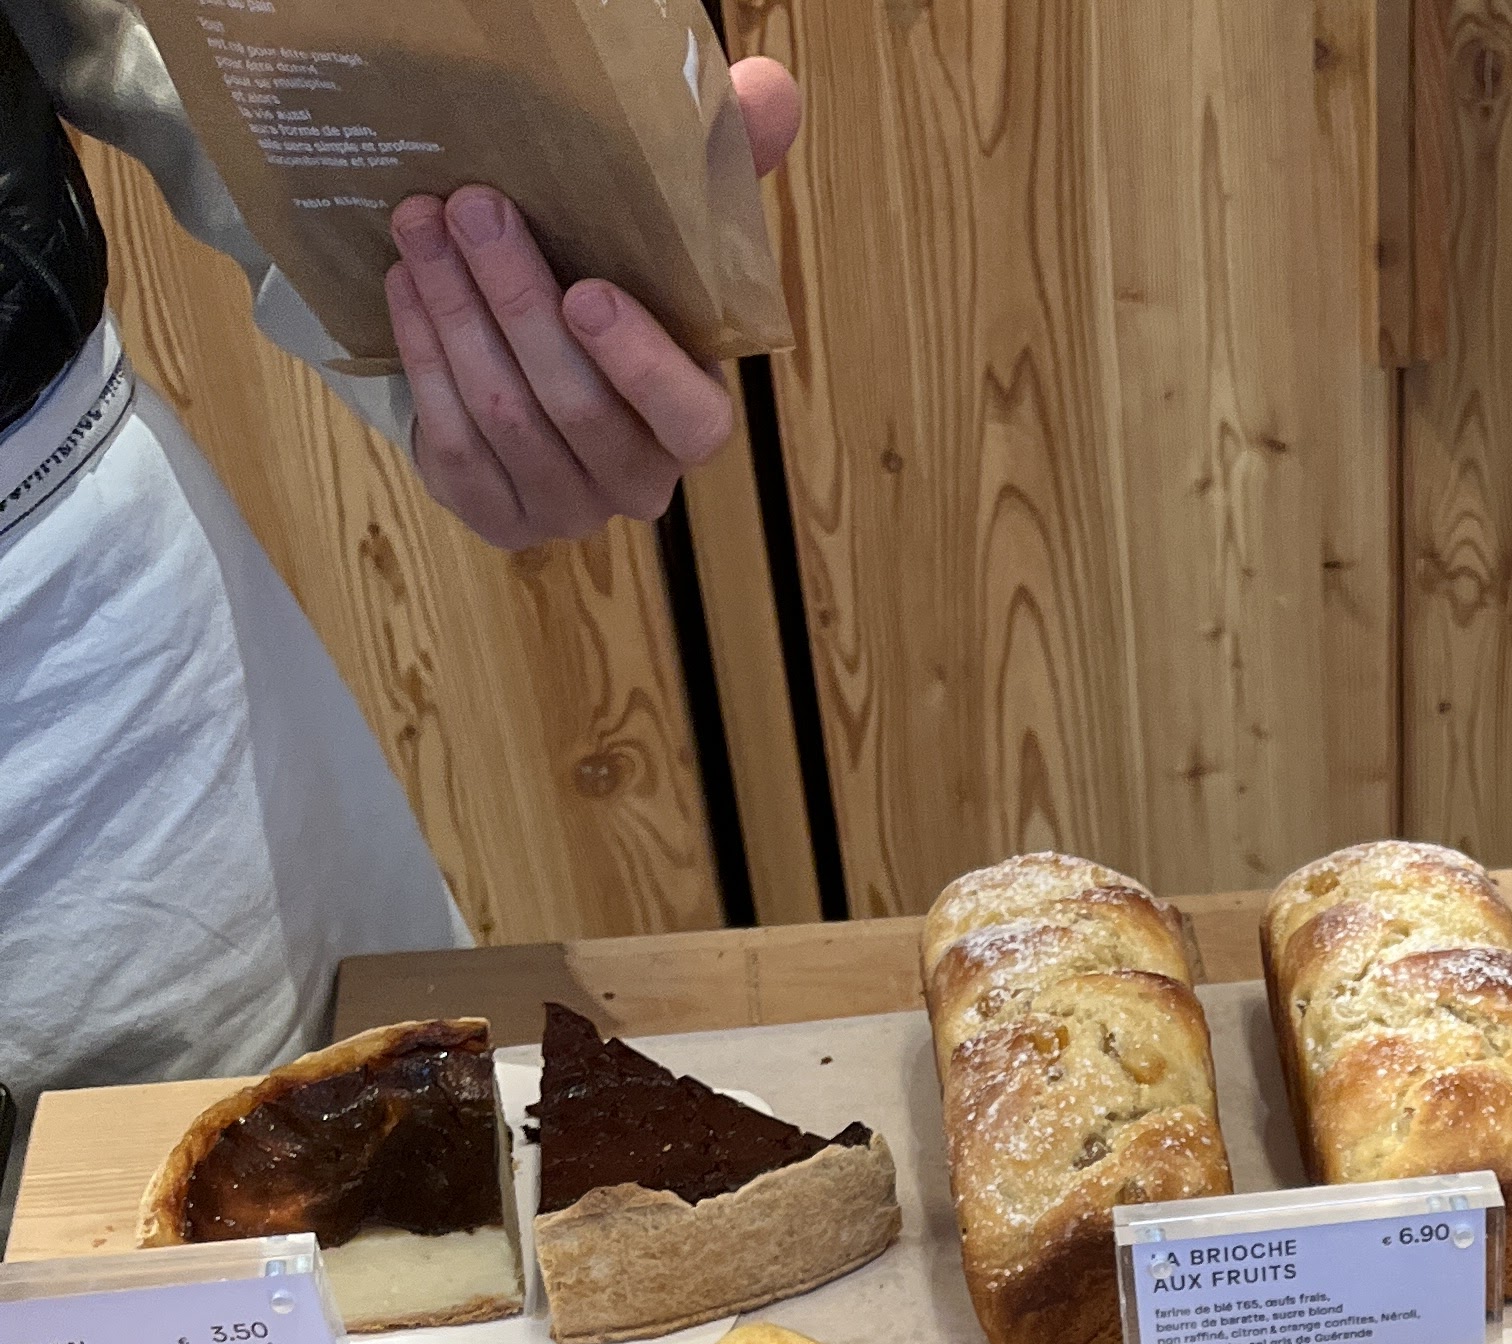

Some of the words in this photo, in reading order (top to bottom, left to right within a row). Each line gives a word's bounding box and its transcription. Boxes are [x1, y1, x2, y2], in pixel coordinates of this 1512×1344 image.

[1190, 1239, 1298, 1266] BRIOCHE
[1382, 1235, 1393, 1246] €
[1399, 1222, 1450, 1245] 6.90
[1153, 1272, 1203, 1294] AUX
[1212, 1263, 1298, 1288] FRUITS
[210, 1321, 269, 1343] 3.50
